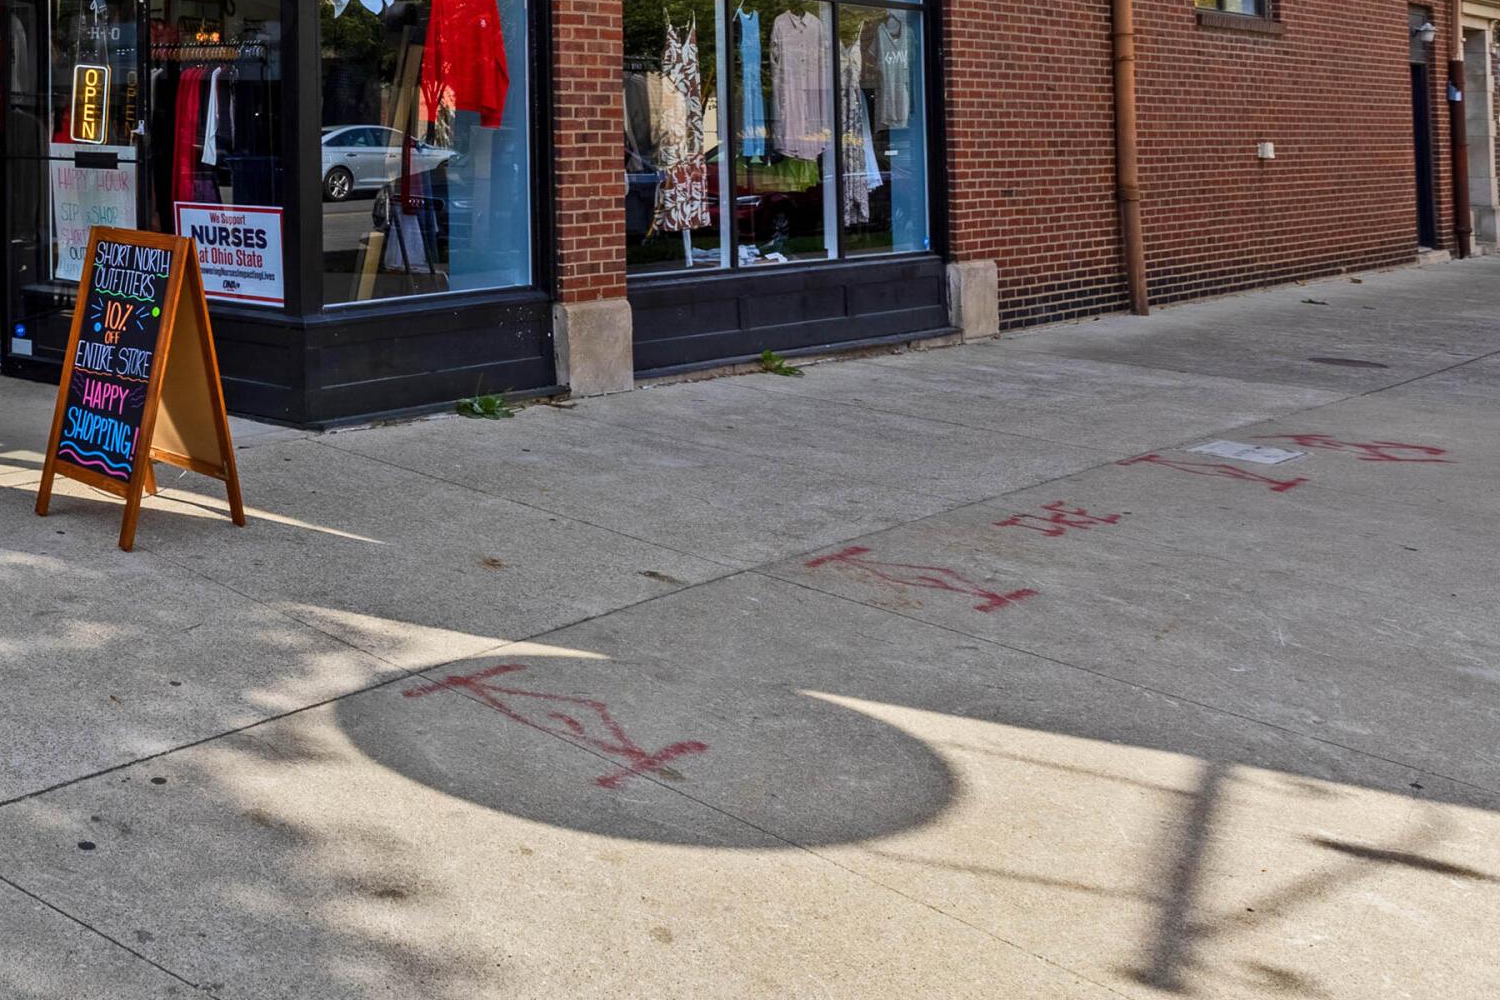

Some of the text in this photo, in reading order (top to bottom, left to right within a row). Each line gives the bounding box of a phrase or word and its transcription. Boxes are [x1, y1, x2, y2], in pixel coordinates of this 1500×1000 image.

[82, 69, 98, 139] OPEN
[97, 170, 131, 192] HOUR
[61, 203, 79, 221] SIP
[91, 206, 118, 225] SHOP
[210, 213, 245, 226] We Support
[191, 224, 267, 249] NURSES
[95, 241, 171, 275] SHORT NORTH
[199, 248, 263, 268] at Ohio State
[95, 268, 155, 298] OUTFITTERS
[104, 300, 134, 331] 10%
[104, 330, 120, 344] OFF
[75, 340, 153, 378] ENTIRE STORE
[83, 377, 129, 415] HAPPY
[64, 406, 139, 461] SHOPPING!
